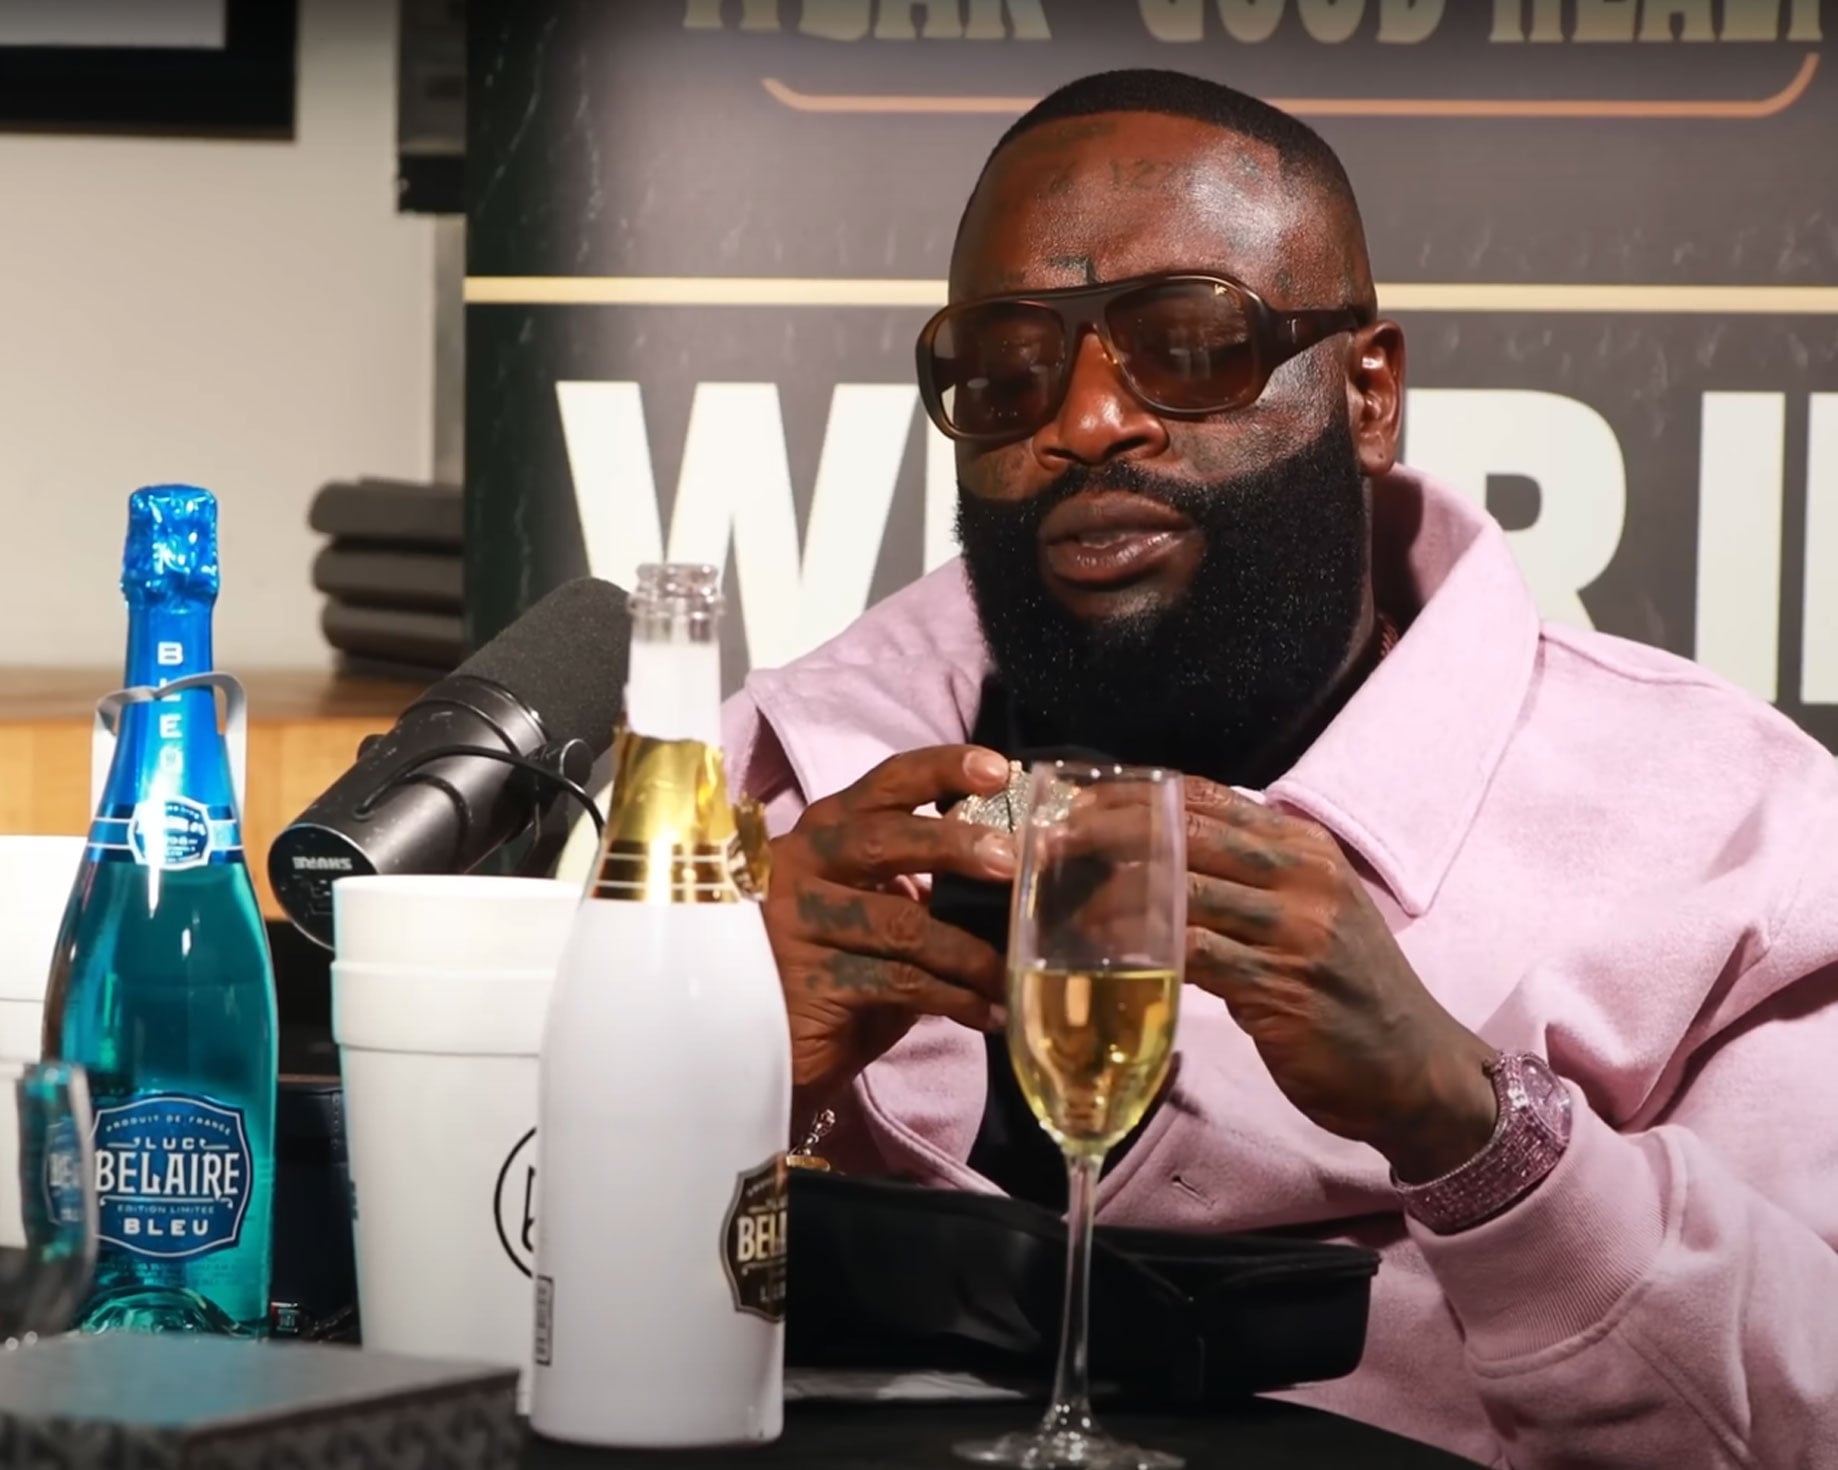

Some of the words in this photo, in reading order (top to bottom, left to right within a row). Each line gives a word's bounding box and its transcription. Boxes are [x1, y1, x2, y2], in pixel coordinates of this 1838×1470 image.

[106, 1114, 159, 1133] PRODUIT
[165, 1114, 181, 1124] DE
[189, 1115, 231, 1136] FRANCE
[145, 1136, 195, 1150] LUC
[95, 1150, 240, 1200] BELAIRE
[123, 1217, 209, 1237] BLEU
